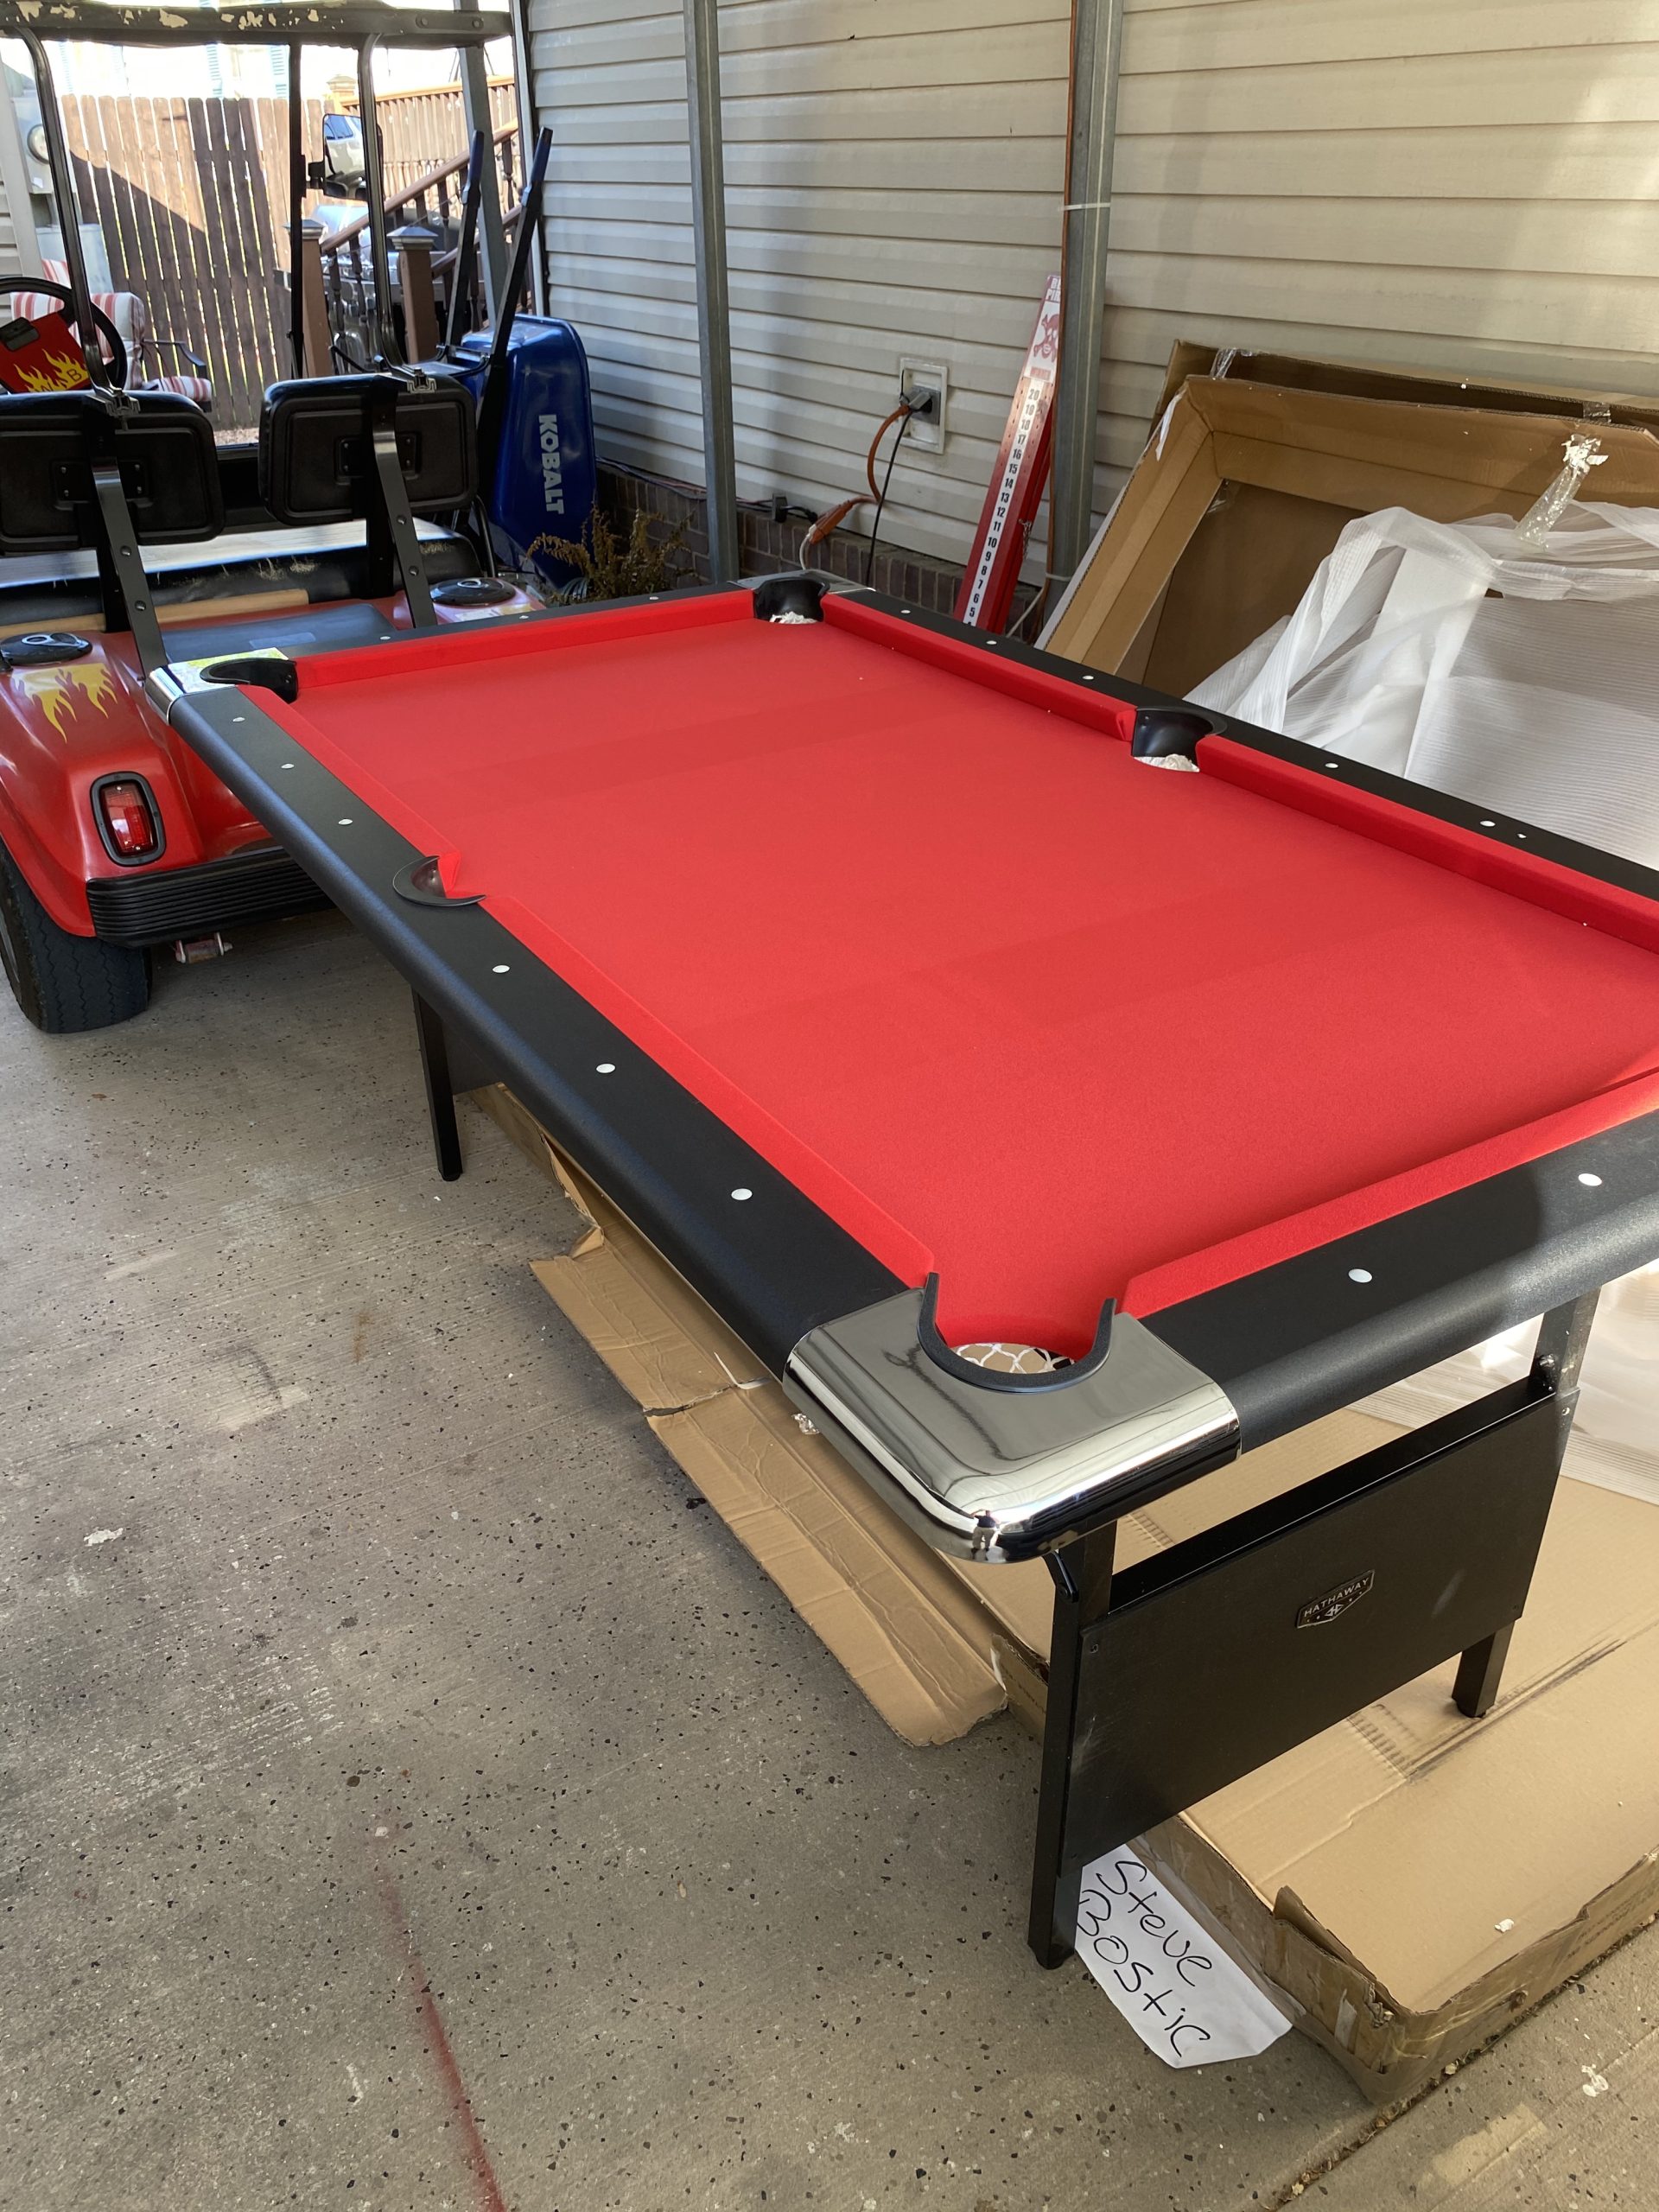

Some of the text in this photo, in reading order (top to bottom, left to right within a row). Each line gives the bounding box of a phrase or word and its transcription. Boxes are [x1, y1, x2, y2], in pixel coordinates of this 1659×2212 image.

[67, 368, 82, 382] B
[1028, 388, 1040, 400] 20
[1025, 404, 1035, 416] 19
[1020, 419, 1030, 430] 18
[1018, 434, 1027, 445] 17
[1013, 448, 1021, 460] 16
[538, 414, 564, 515] KOBALT
[1009, 463, 1018, 474] 15
[1005, 477, 1014, 489] 14
[1001, 492, 1009, 503] 13
[996, 506, 1006, 518] 12
[993, 521, 1001, 532] 11
[988, 537, 997, 548] 10
[985, 551, 992, 562] 9
[981, 565, 987, 575] 8
[977, 579, 983, 589] 7
[973, 593, 980, 604] 6
[969, 607, 976, 618] 5
[1304, 1577, 1370, 1618] HATHAWAY
